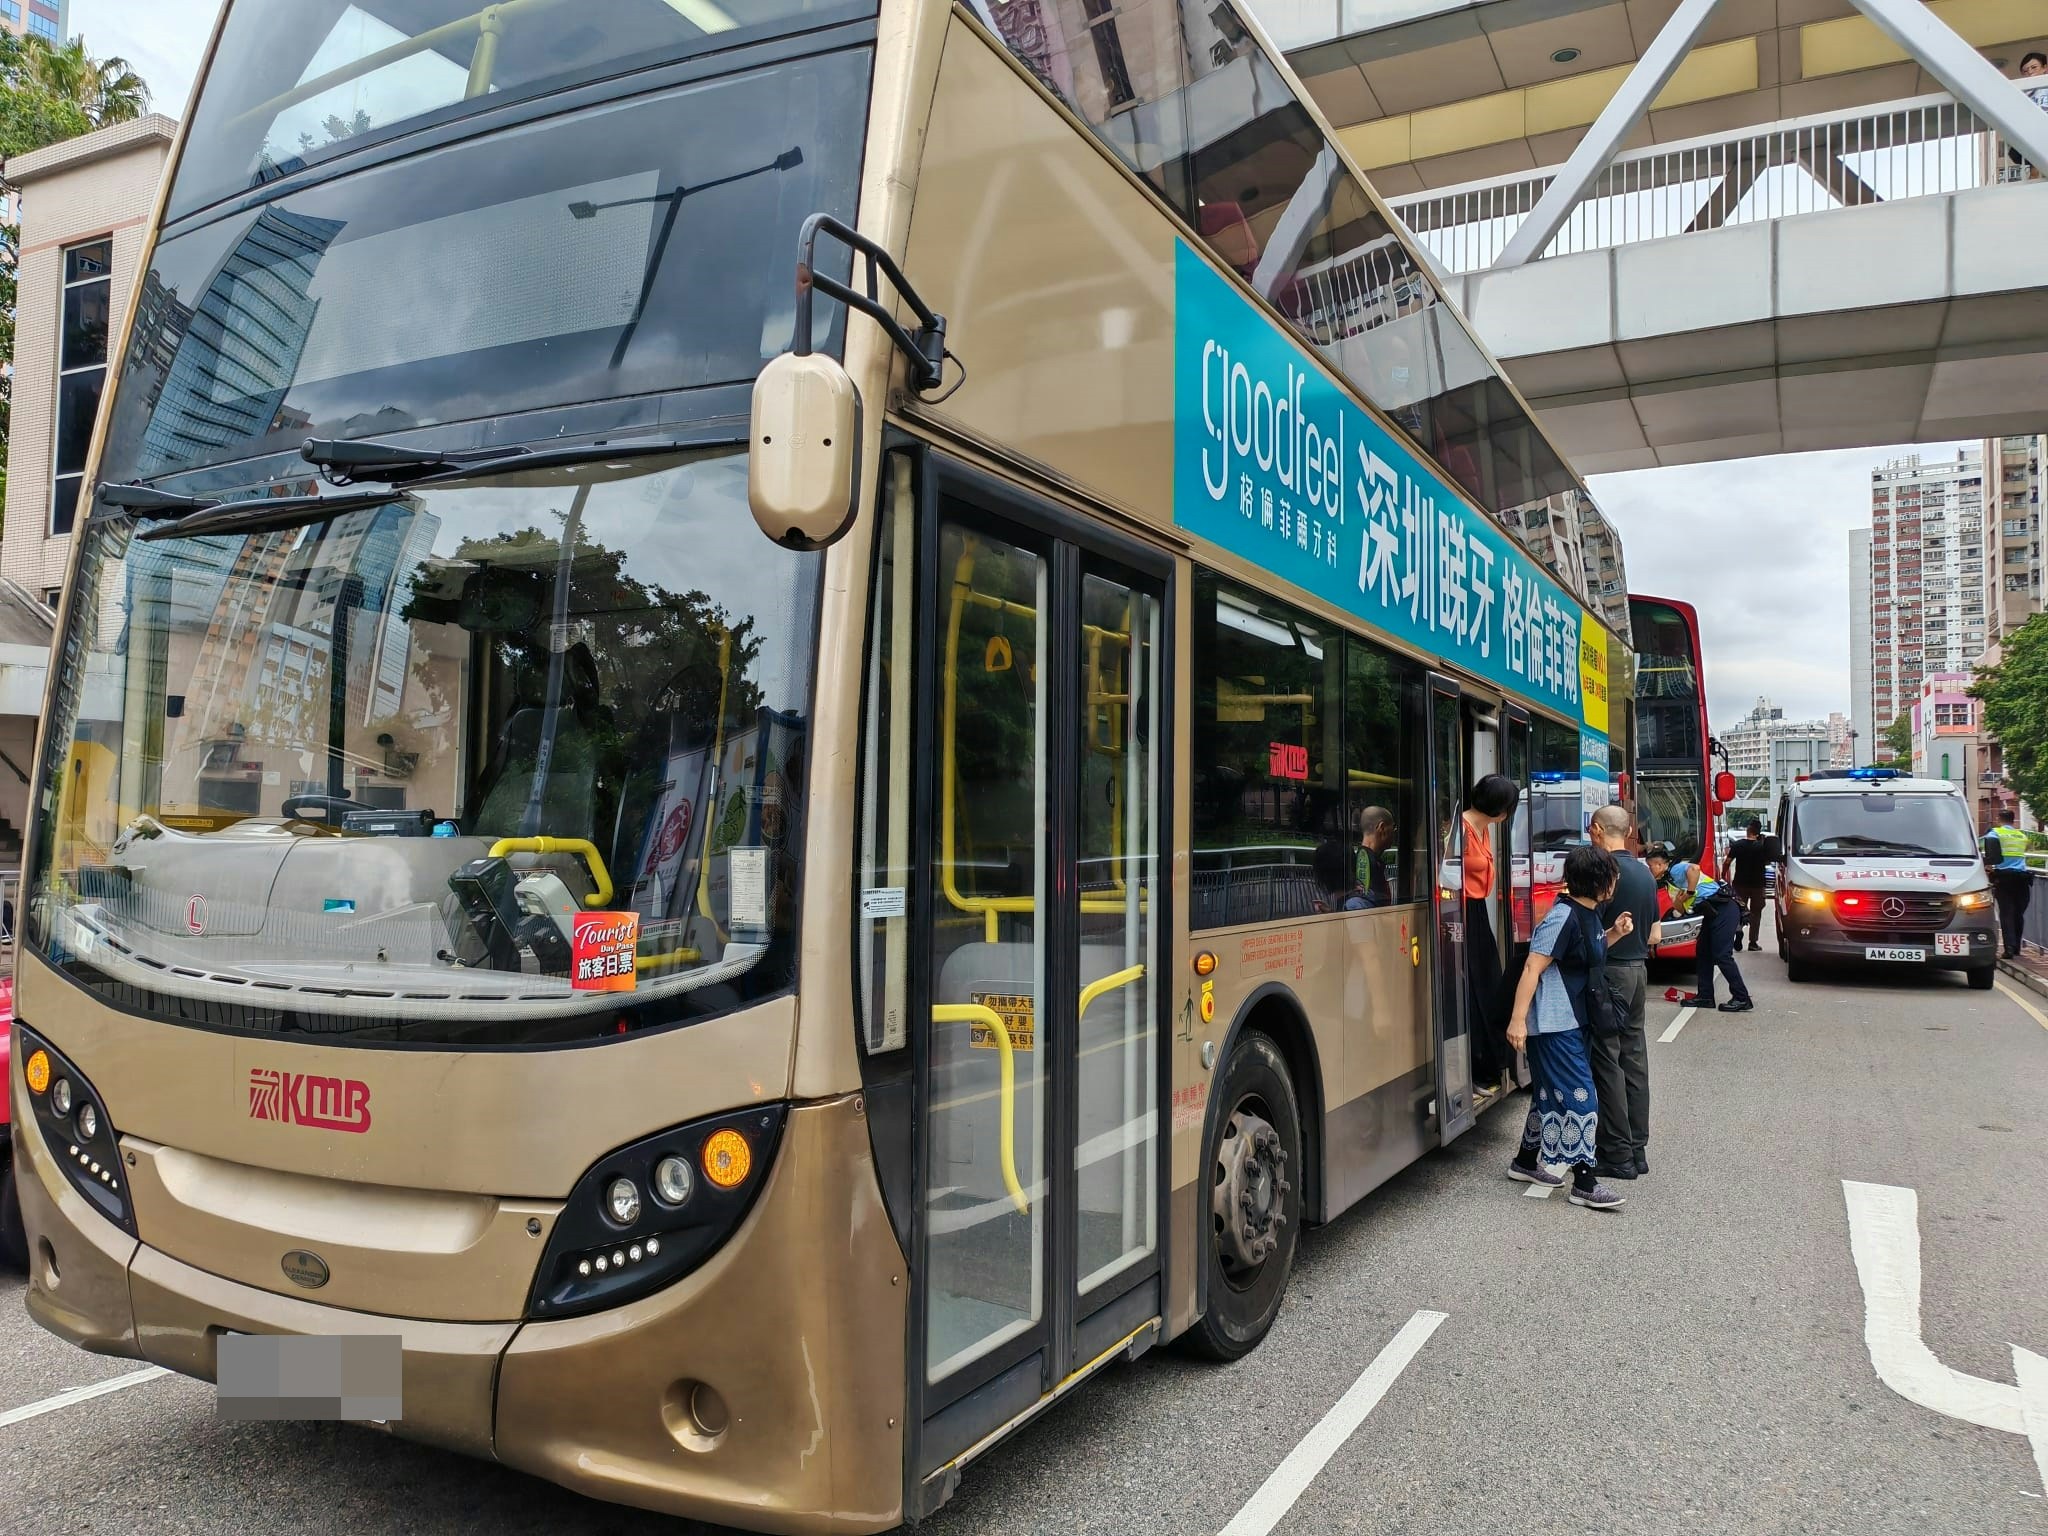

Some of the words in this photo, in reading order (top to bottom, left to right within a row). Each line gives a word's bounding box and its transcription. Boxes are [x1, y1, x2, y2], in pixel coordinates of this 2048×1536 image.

[1202, 339, 1344, 525] goodfeel
[1240, 472, 1337, 568] 格倫菲爾牙科
[1357, 439, 1495, 658] 深圳睇牙
[1502, 556, 1577, 704] 格倫菲爾
[1281, 743, 1308, 780] KMB
[1856, 870, 1924, 879] POLICE
[575, 921, 634, 950] Tourist
[601, 944, 615, 953] Day
[616, 942, 634, 951] Pass
[1937, 935, 1949, 945] EU
[1951, 935, 1966, 945] KE
[1943, 944, 1961, 954] 53
[578, 951, 633, 979] 旅客日票
[1869, 950, 1886, 959] AM
[1889, 950, 1922, 960] 6085
[282, 1072, 372, 1133] KMB
